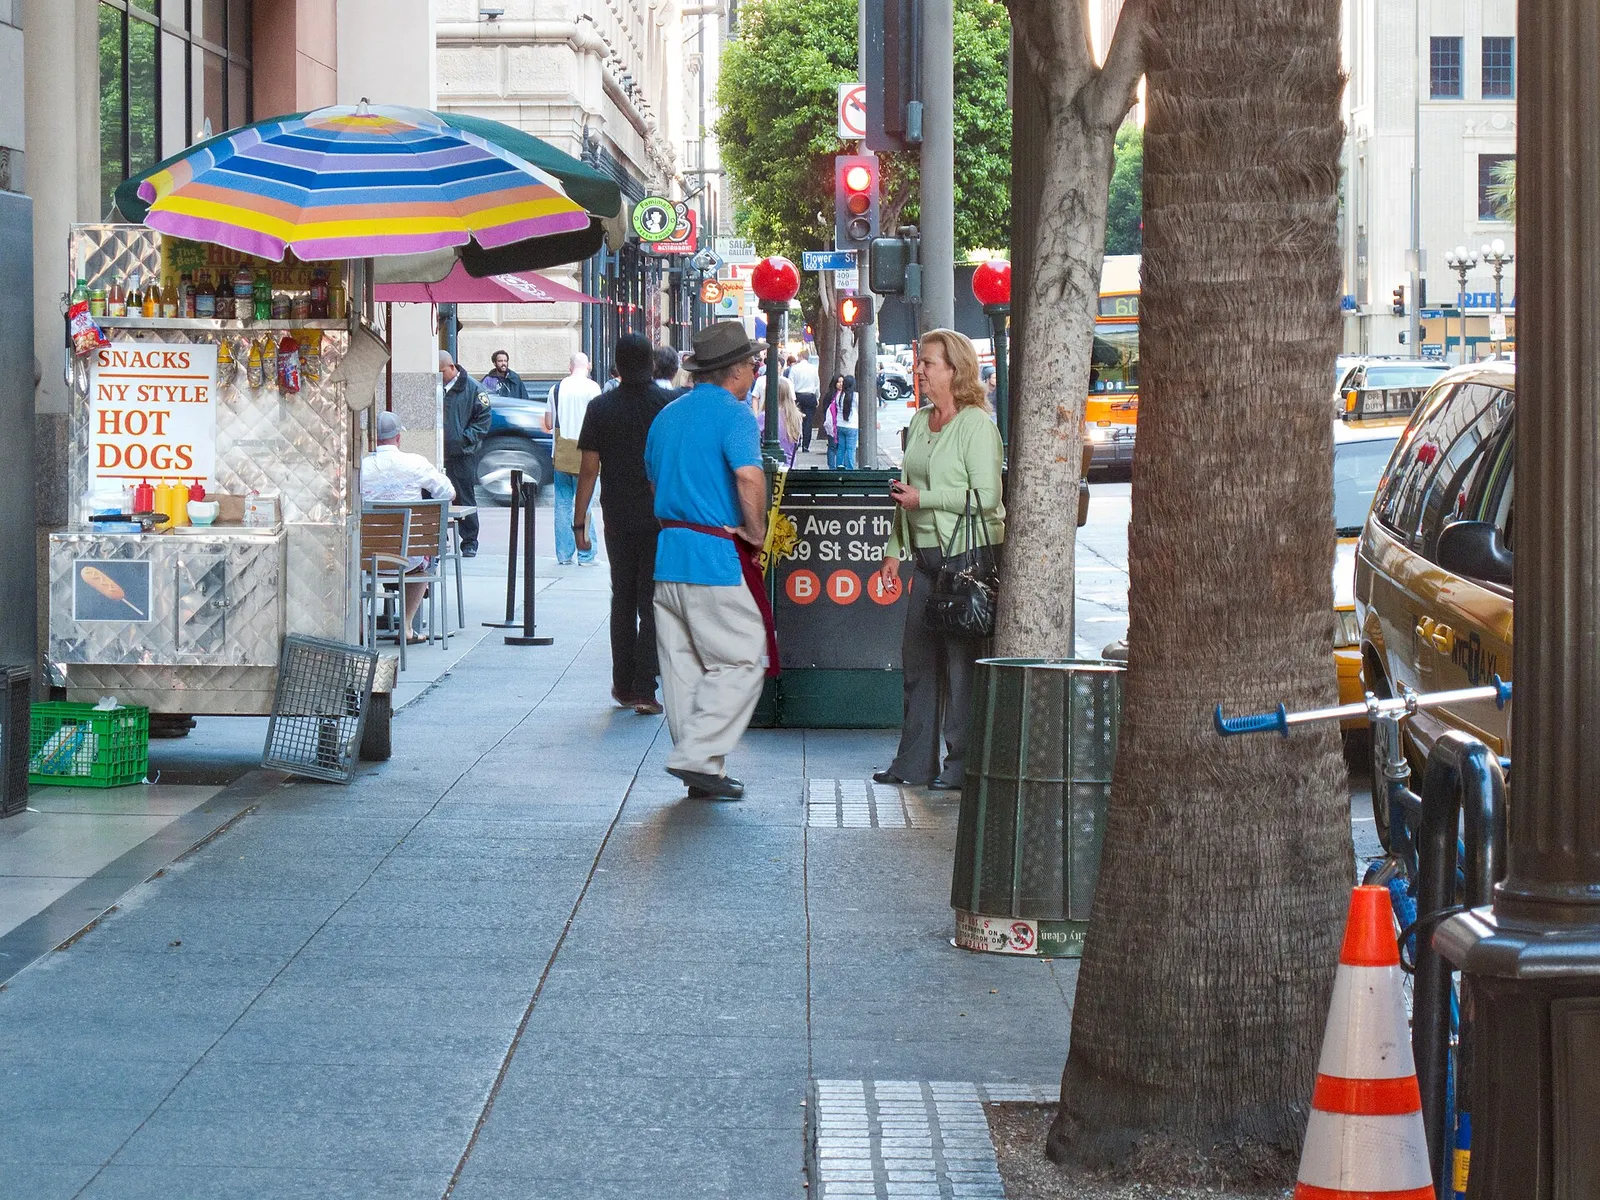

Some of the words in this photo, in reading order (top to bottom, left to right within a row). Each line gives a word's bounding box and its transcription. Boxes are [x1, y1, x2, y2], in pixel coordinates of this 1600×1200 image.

[177, 254, 201, 264] Best
[178, 247, 196, 256] The
[805, 253, 832, 264] Flower
[845, 253, 854, 263] St
[97, 350, 190, 369] SNACKS
[97, 384, 130, 401] NY
[137, 385, 208, 403] STYLE
[97, 410, 170, 436] HOT
[97, 444, 193, 470] DOGS
[803, 515, 841, 536] Ave
[846, 515, 866, 536] of
[872, 515, 892, 536] th
[819, 541, 841, 561] St
[795, 576, 813, 597] B
[836, 576, 855, 597] D
